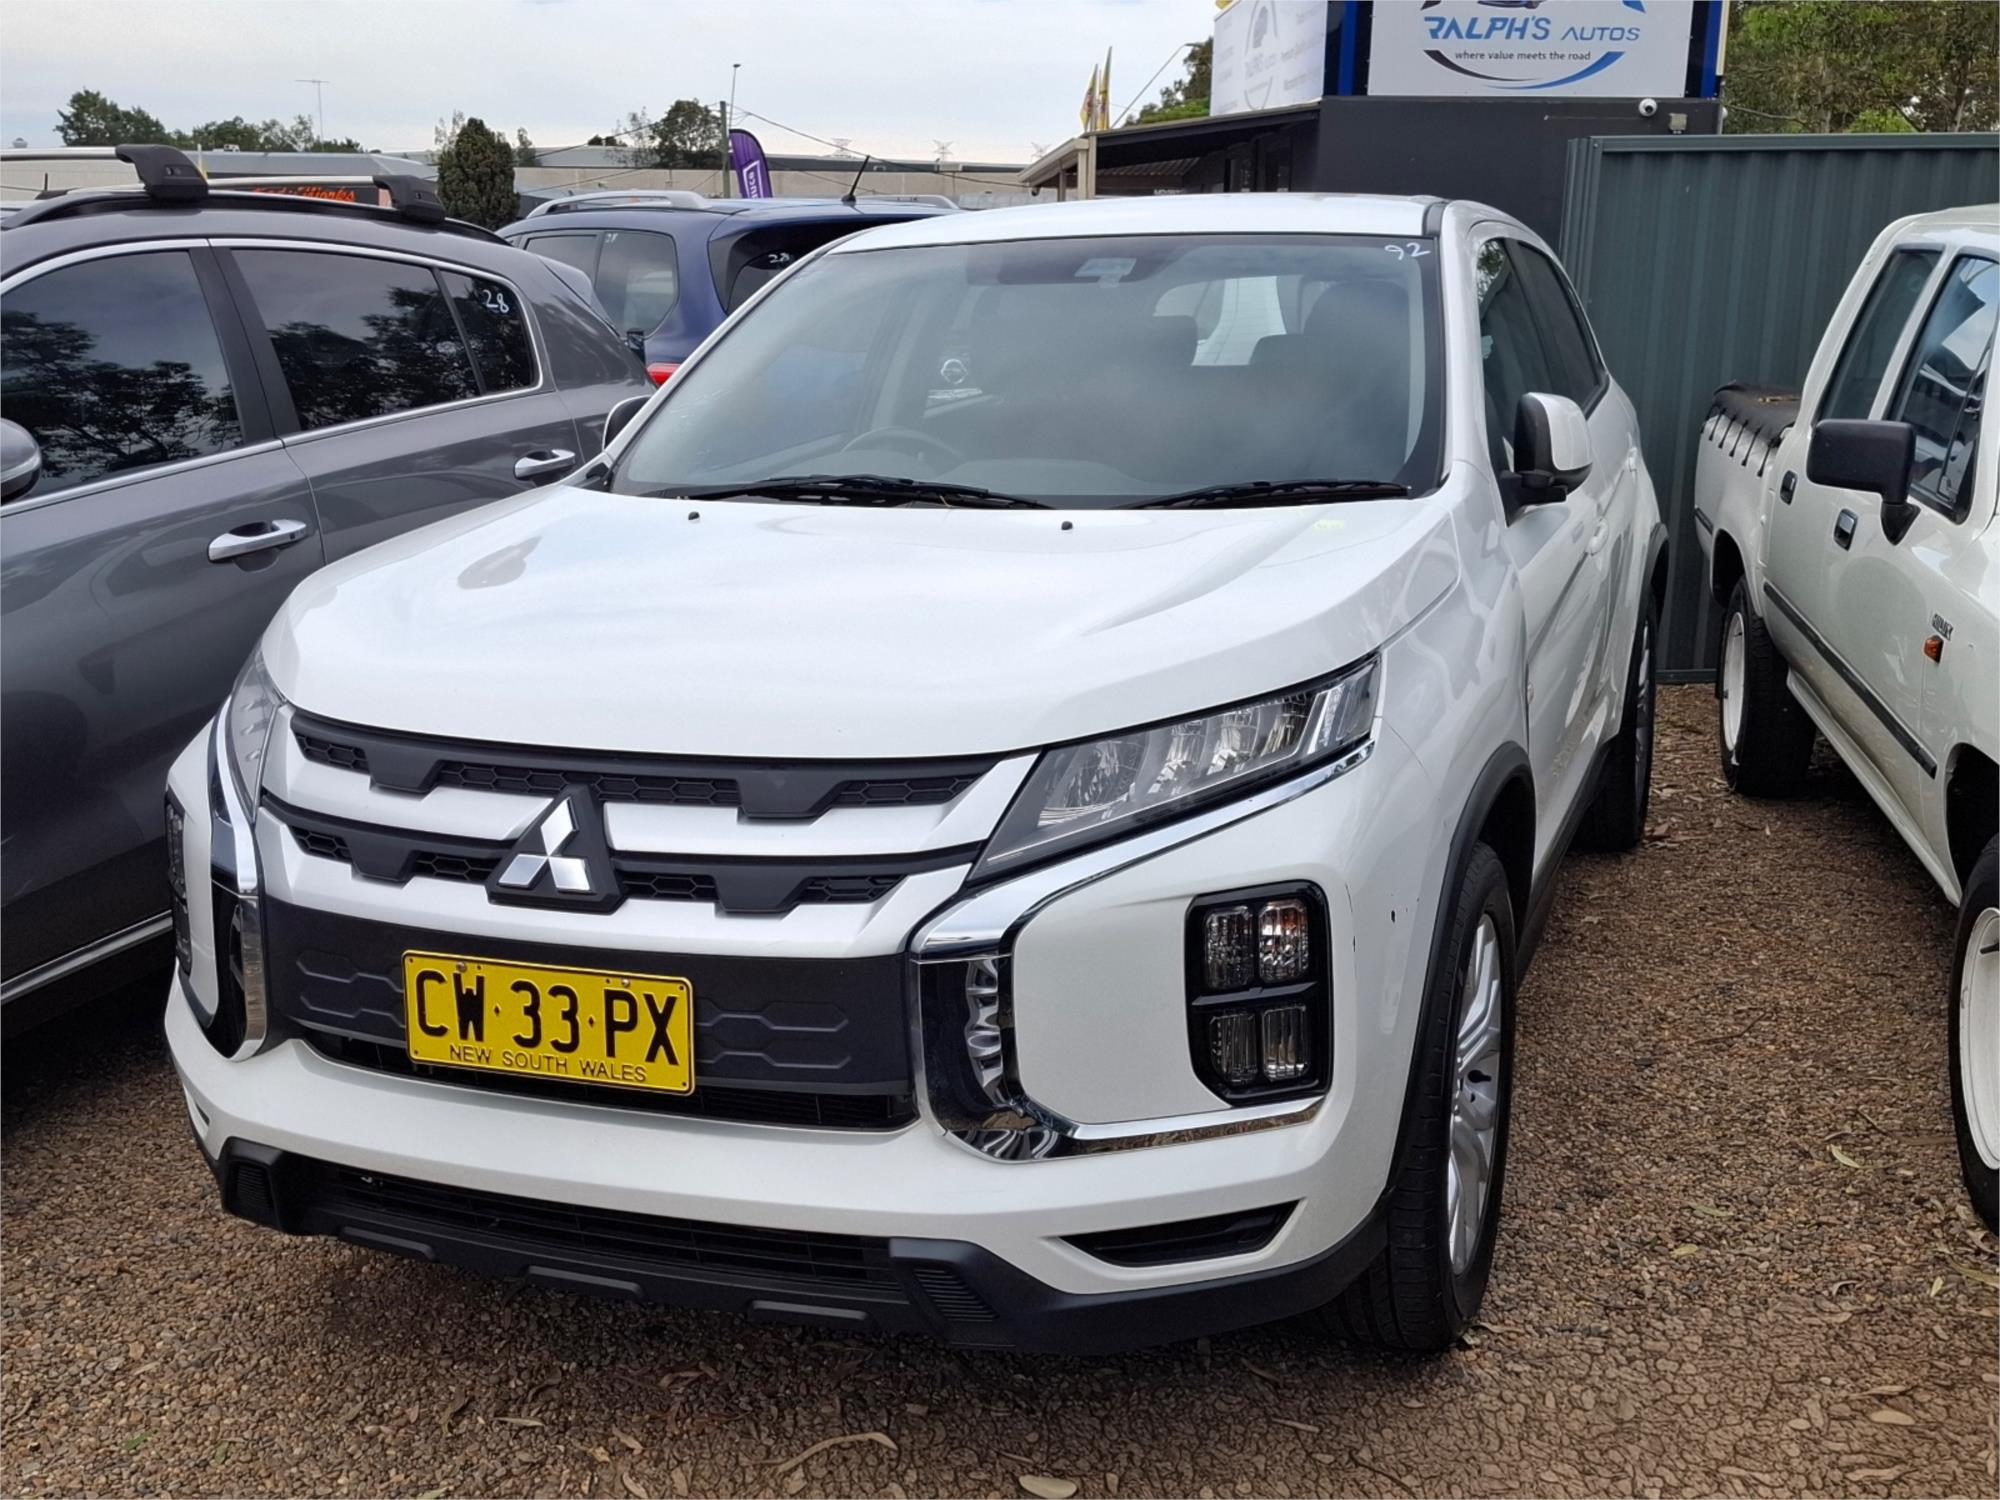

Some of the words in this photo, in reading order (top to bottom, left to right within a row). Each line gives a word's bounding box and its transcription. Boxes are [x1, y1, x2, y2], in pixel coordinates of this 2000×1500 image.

[1424, 16, 1551, 40] RALPH'S
[1561, 27, 1641, 41] AUTOS
[1455, 50, 1486, 61] where
[1488, 50, 1514, 61] value
[1517, 51, 1547, 61] meets
[1549, 51, 1565, 61] the
[1568, 51, 1591, 61] road
[1384, 242, 1431, 260] 92
[482, 289, 510, 313] 28
[415, 969, 486, 1042] CW
[510, 979, 580, 1054] 33
[603, 989, 680, 1066] PX
[450, 1044, 492, 1065] NEW
[502, 1050, 569, 1074] SOUTH
[580, 1059, 647, 1083] WALES
